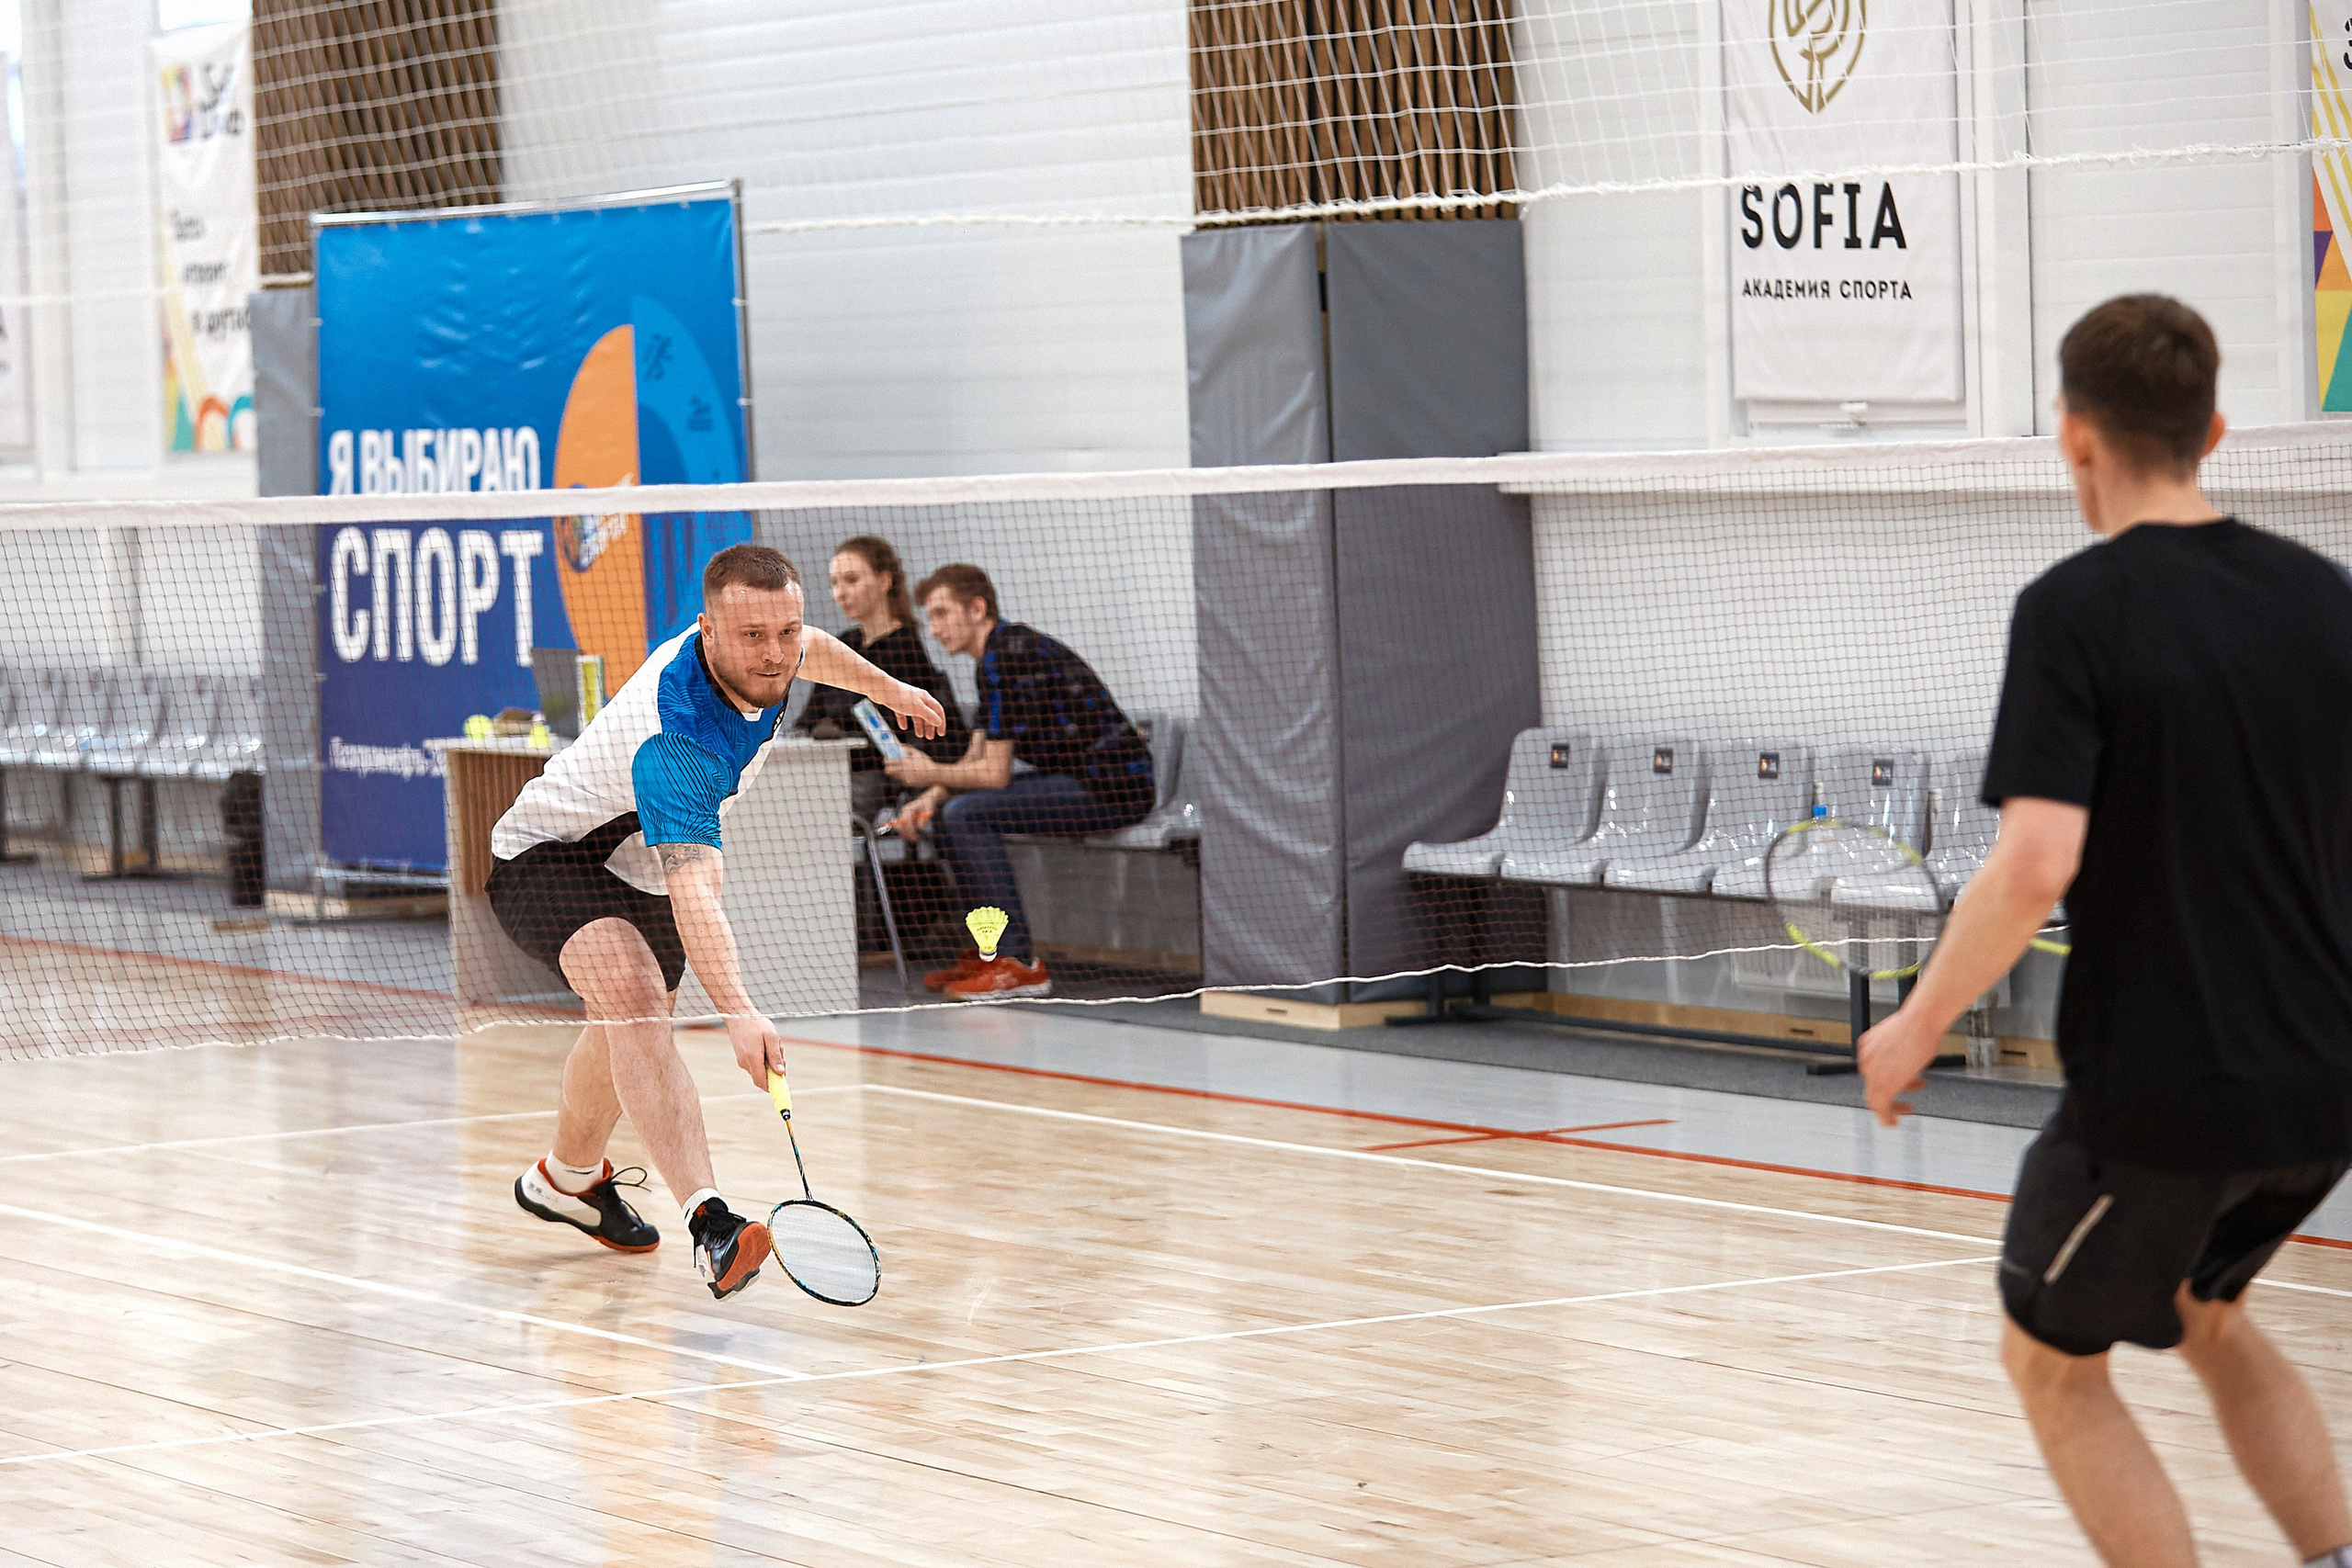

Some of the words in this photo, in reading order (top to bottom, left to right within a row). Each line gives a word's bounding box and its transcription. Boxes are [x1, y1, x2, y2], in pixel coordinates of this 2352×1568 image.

[1740, 182, 1907, 250] SOFIA
[1742, 278, 1831, 300] АКАДЕМИЯ
[1839, 278, 1913, 300] СПОРТА
[328, 429, 355, 496] Я
[359, 424, 541, 495] ВЫБИРАЮ
[329, 525, 544, 668] СПОРТ
